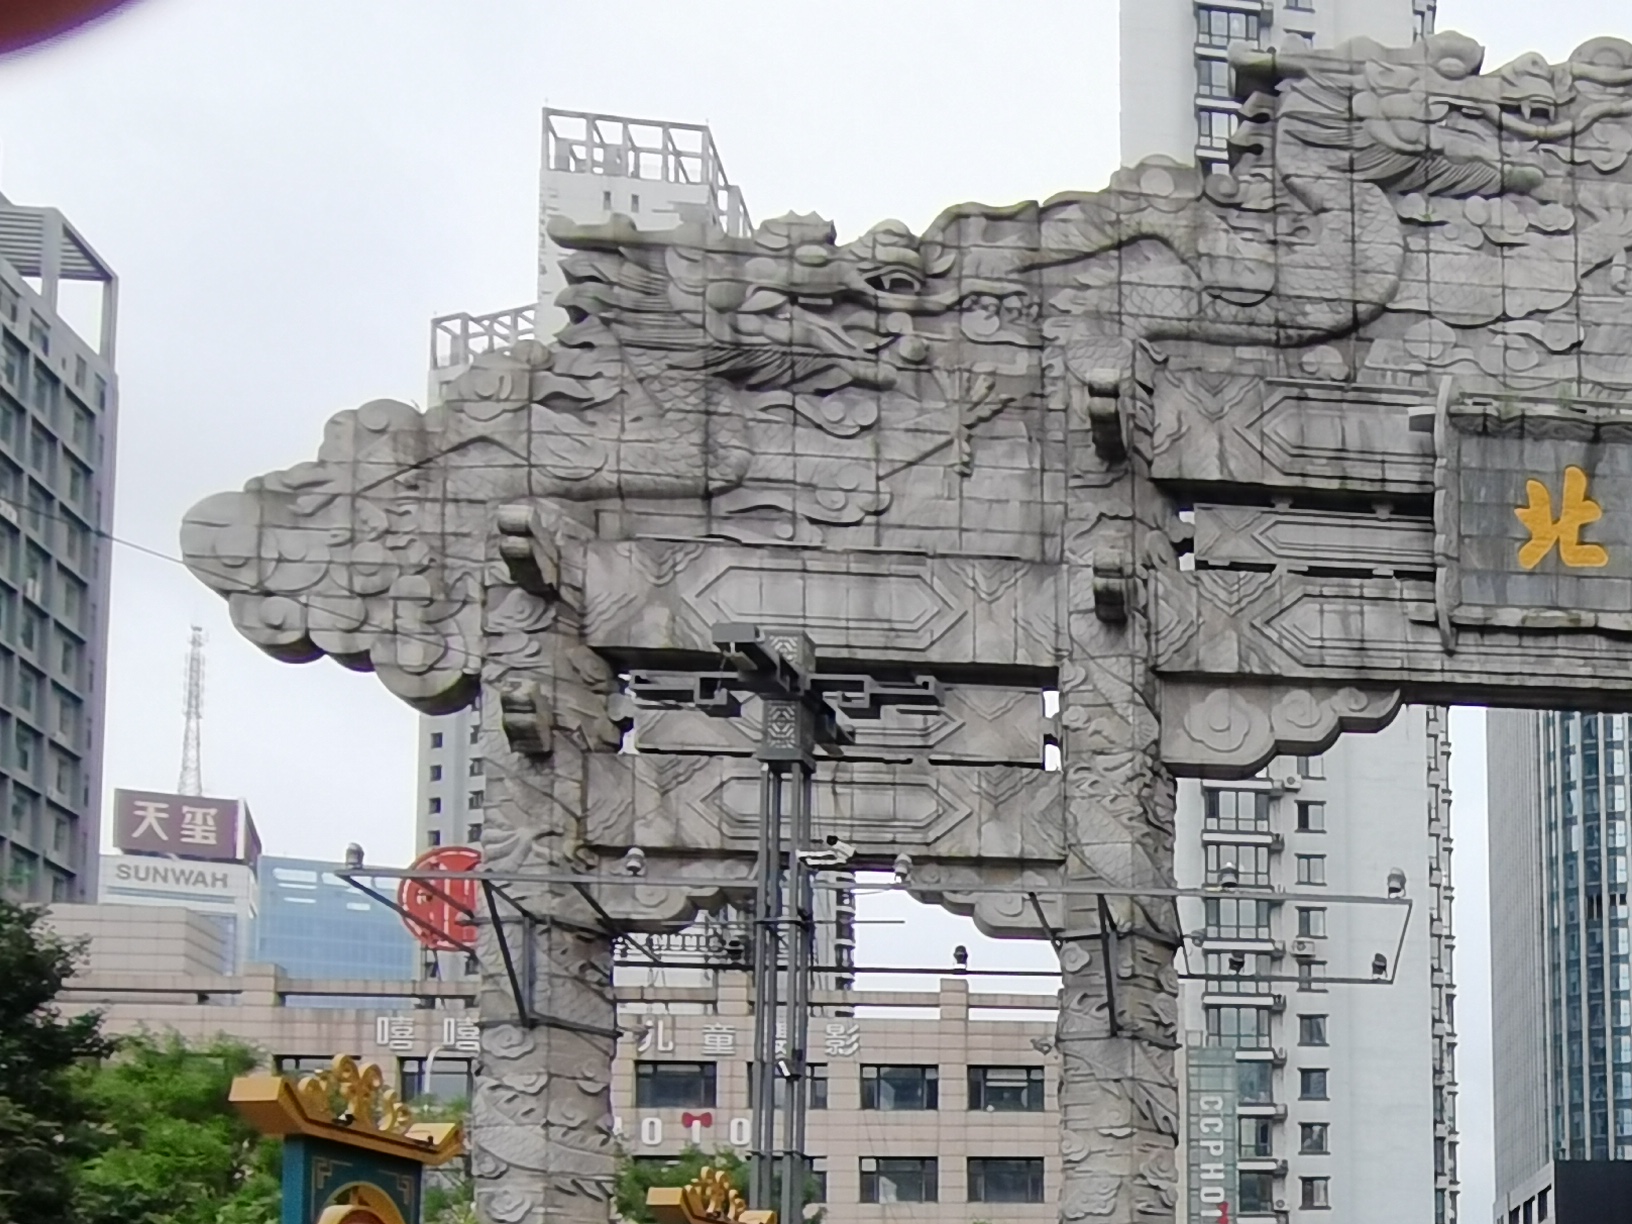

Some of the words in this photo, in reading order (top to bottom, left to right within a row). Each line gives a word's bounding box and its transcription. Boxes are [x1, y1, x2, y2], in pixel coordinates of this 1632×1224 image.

[131, 801, 218, 845] 天玺
[115, 863, 229, 888] SUNWAH
[635, 1018, 860, 1057] 儿童影
